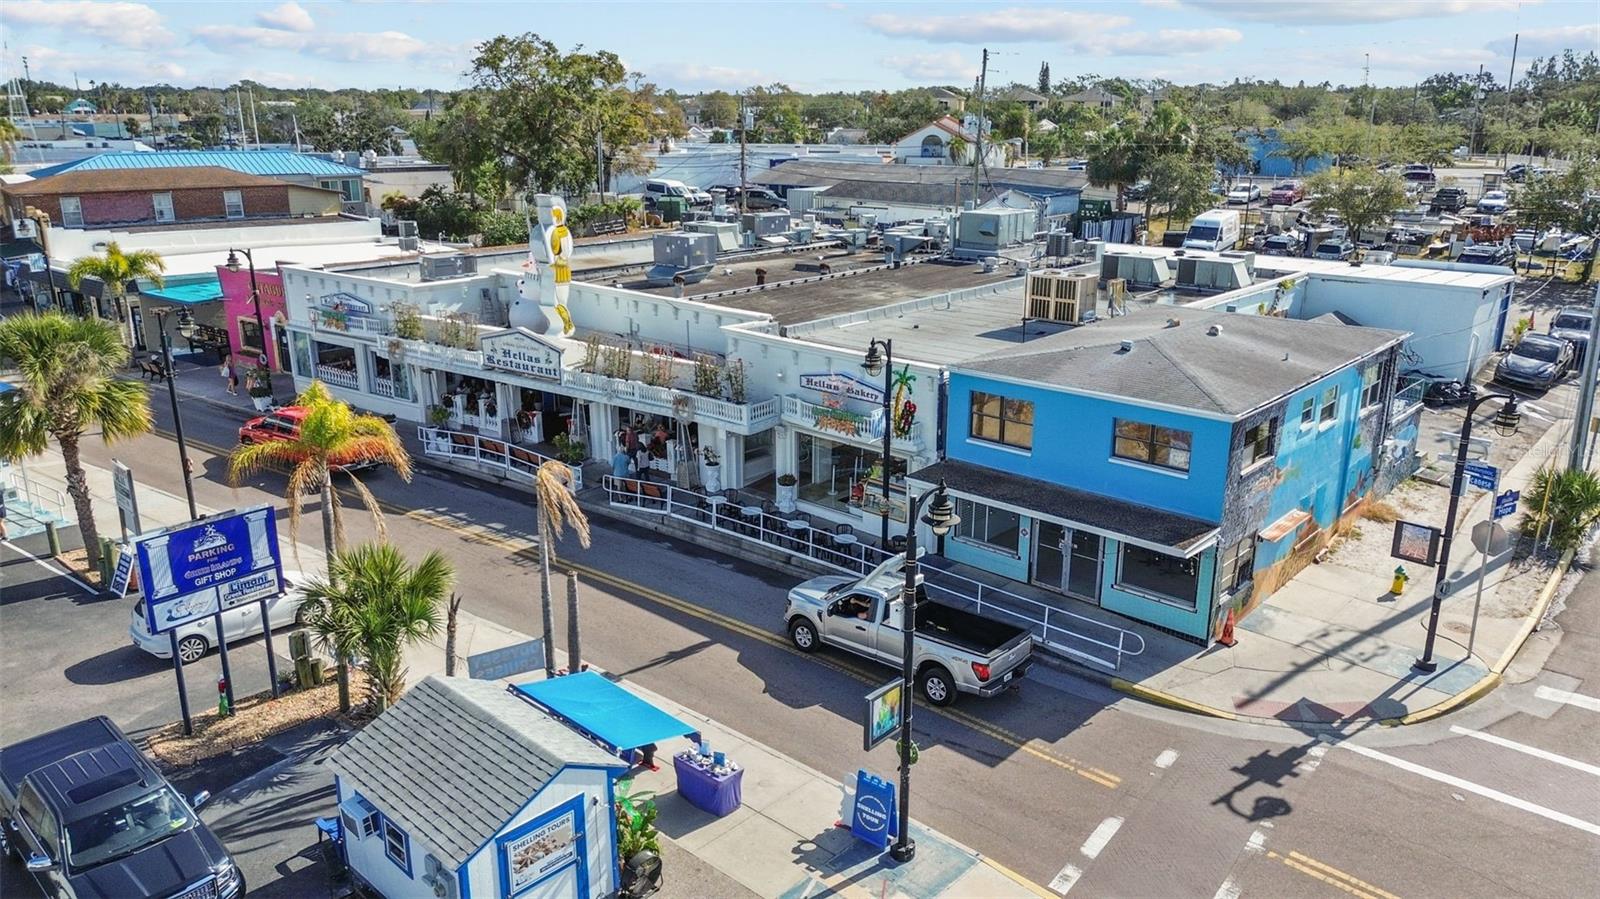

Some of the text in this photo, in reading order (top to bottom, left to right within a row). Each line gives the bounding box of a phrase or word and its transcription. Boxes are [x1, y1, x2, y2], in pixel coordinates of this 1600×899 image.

[502, 347, 541, 364] Hellas
[486, 354, 558, 377] Restaurant
[805, 377, 840, 392] Hellas
[846, 386, 880, 400] Bakery
[188, 543, 235, 562] PARKING
[195, 567, 237, 586] GIFT SHOP
[857, 802, 887, 820] SHELLING
[862, 812, 879, 824] TOUR
[512, 816, 570, 852] SHELLING TOURS
